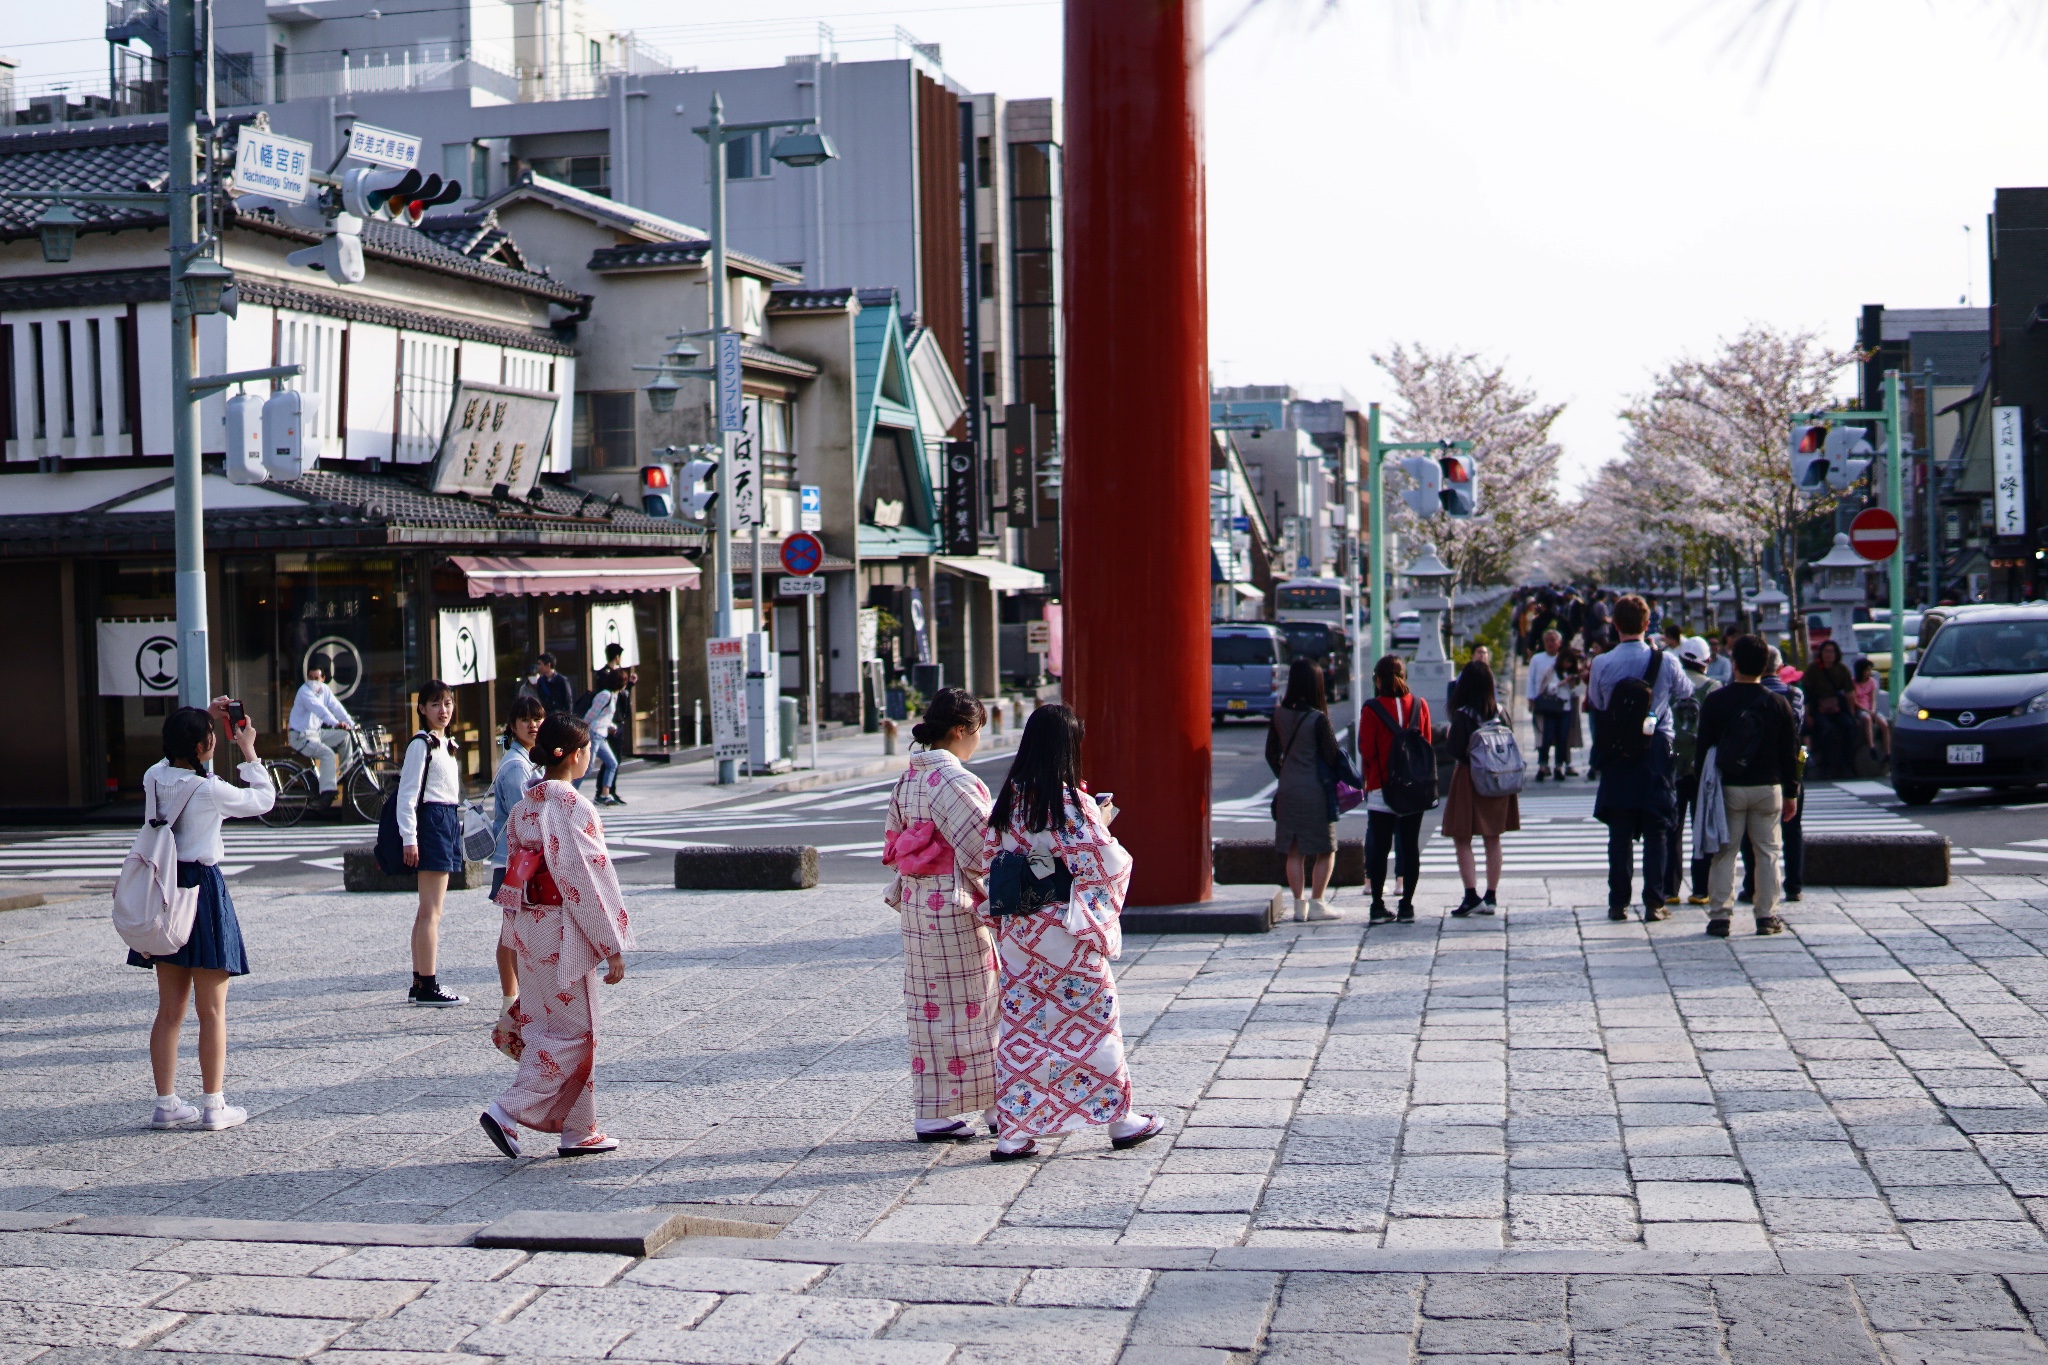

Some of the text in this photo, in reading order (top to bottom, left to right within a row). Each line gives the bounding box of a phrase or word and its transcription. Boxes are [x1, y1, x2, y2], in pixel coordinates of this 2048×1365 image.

[243, 140, 306, 176] 八幡宮前
[354, 132, 415, 162] 時差式信号機
[243, 169, 301, 193] Hachimangu Shrine
[783, 581, 822, 591] ここから
